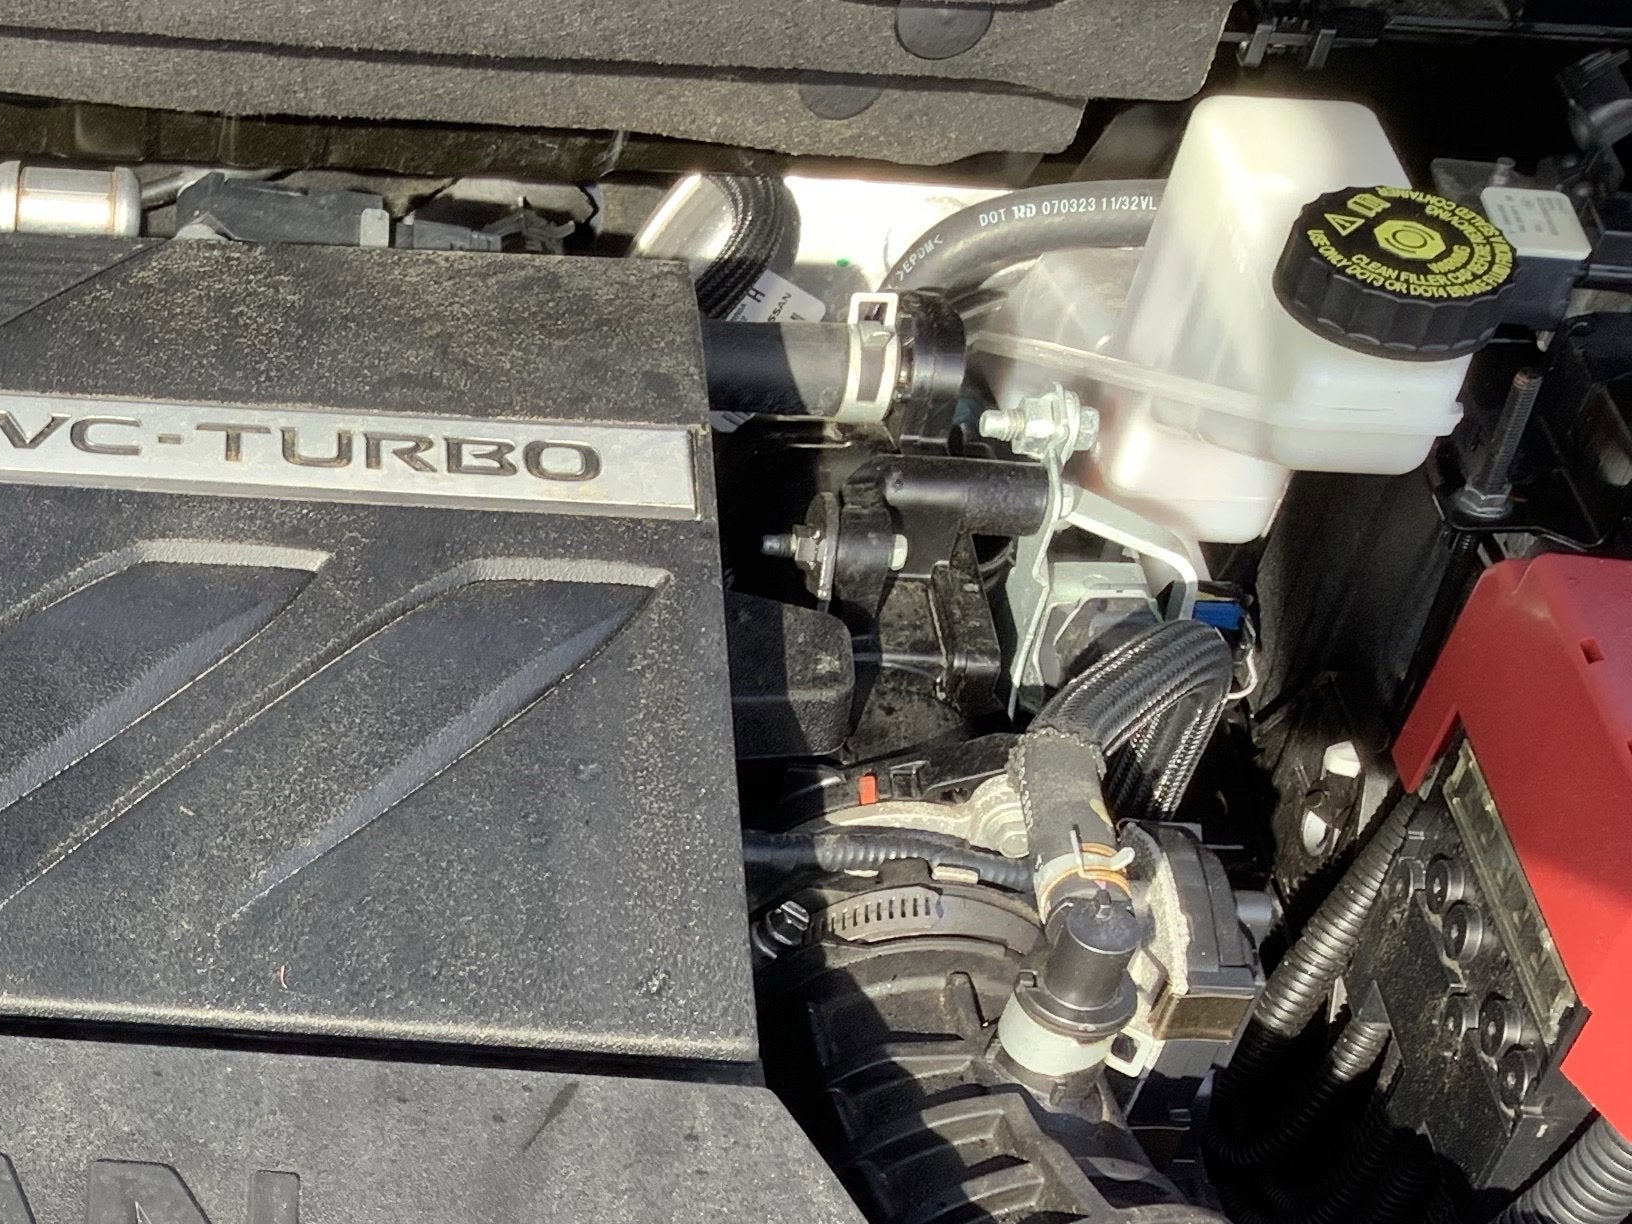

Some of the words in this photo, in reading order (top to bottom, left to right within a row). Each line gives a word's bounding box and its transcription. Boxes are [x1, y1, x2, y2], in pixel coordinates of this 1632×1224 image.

[1375, 184, 1457, 210] CONTAINER
[979, 209, 1006, 226] DOT
[1042, 198, 1096, 215] 070323
[1101, 196, 1157, 211] 11/32VL
[1424, 204, 1488, 243] REMOVING
[1318, 246, 1352, 267] ONLY
[1351, 254, 1399, 280] CLEAN
[1345, 265, 1385, 287] DOT3
[1385, 280, 1408, 294] OR
[1400, 270, 1451, 286] FILLER
[1410, 283, 1448, 298] DOT4
